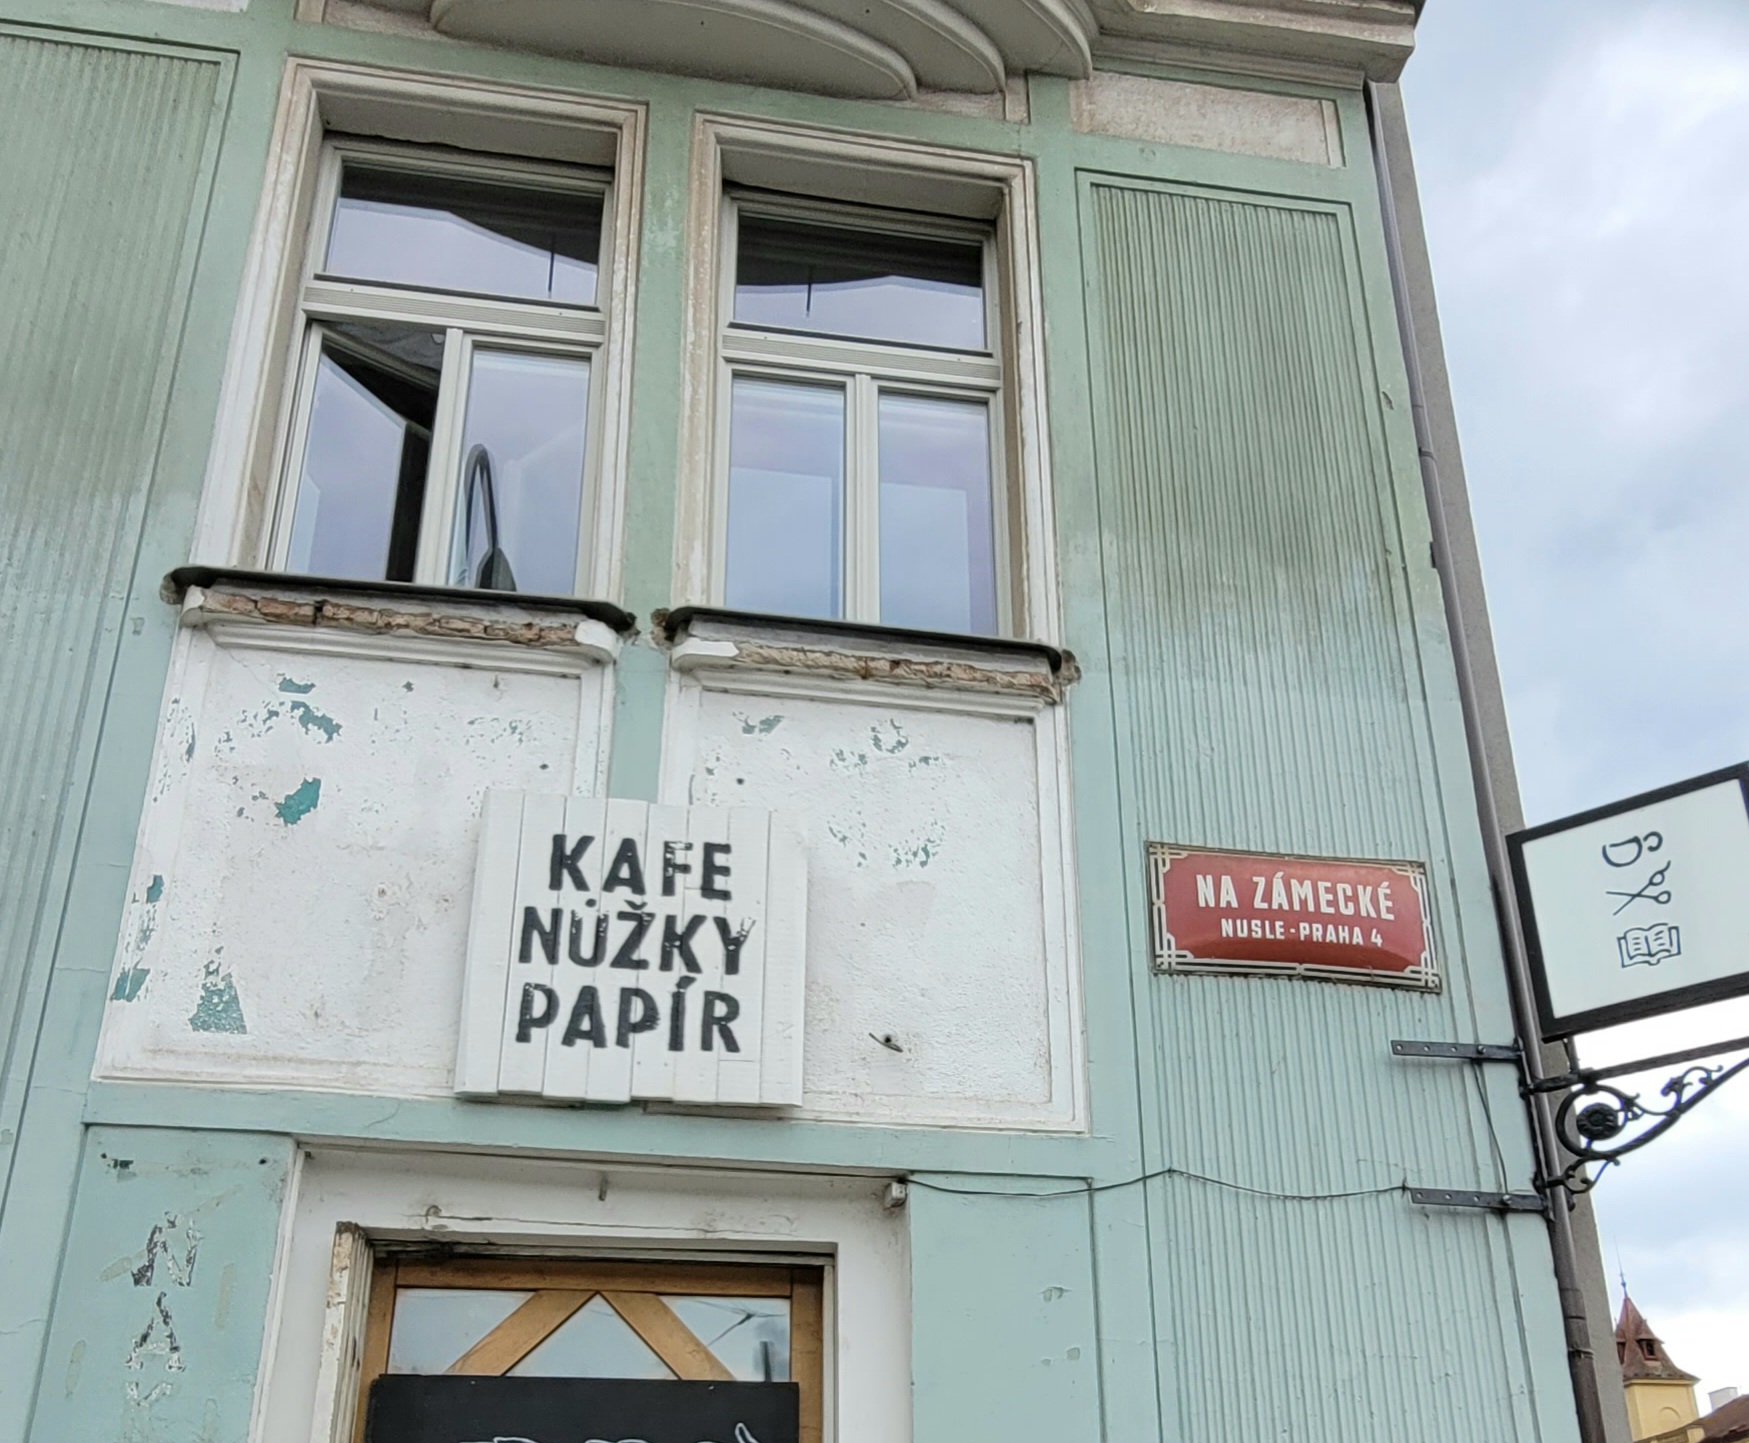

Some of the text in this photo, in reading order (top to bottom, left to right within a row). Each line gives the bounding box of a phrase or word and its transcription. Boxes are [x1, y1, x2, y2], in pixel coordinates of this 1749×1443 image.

[549, 833, 732, 901] KAFE
[1196, 871, 1395, 921] NA ZÁMECKÉ
[1370, 928, 1383, 947] 4
[515, 975, 740, 1053] PAPÍR
